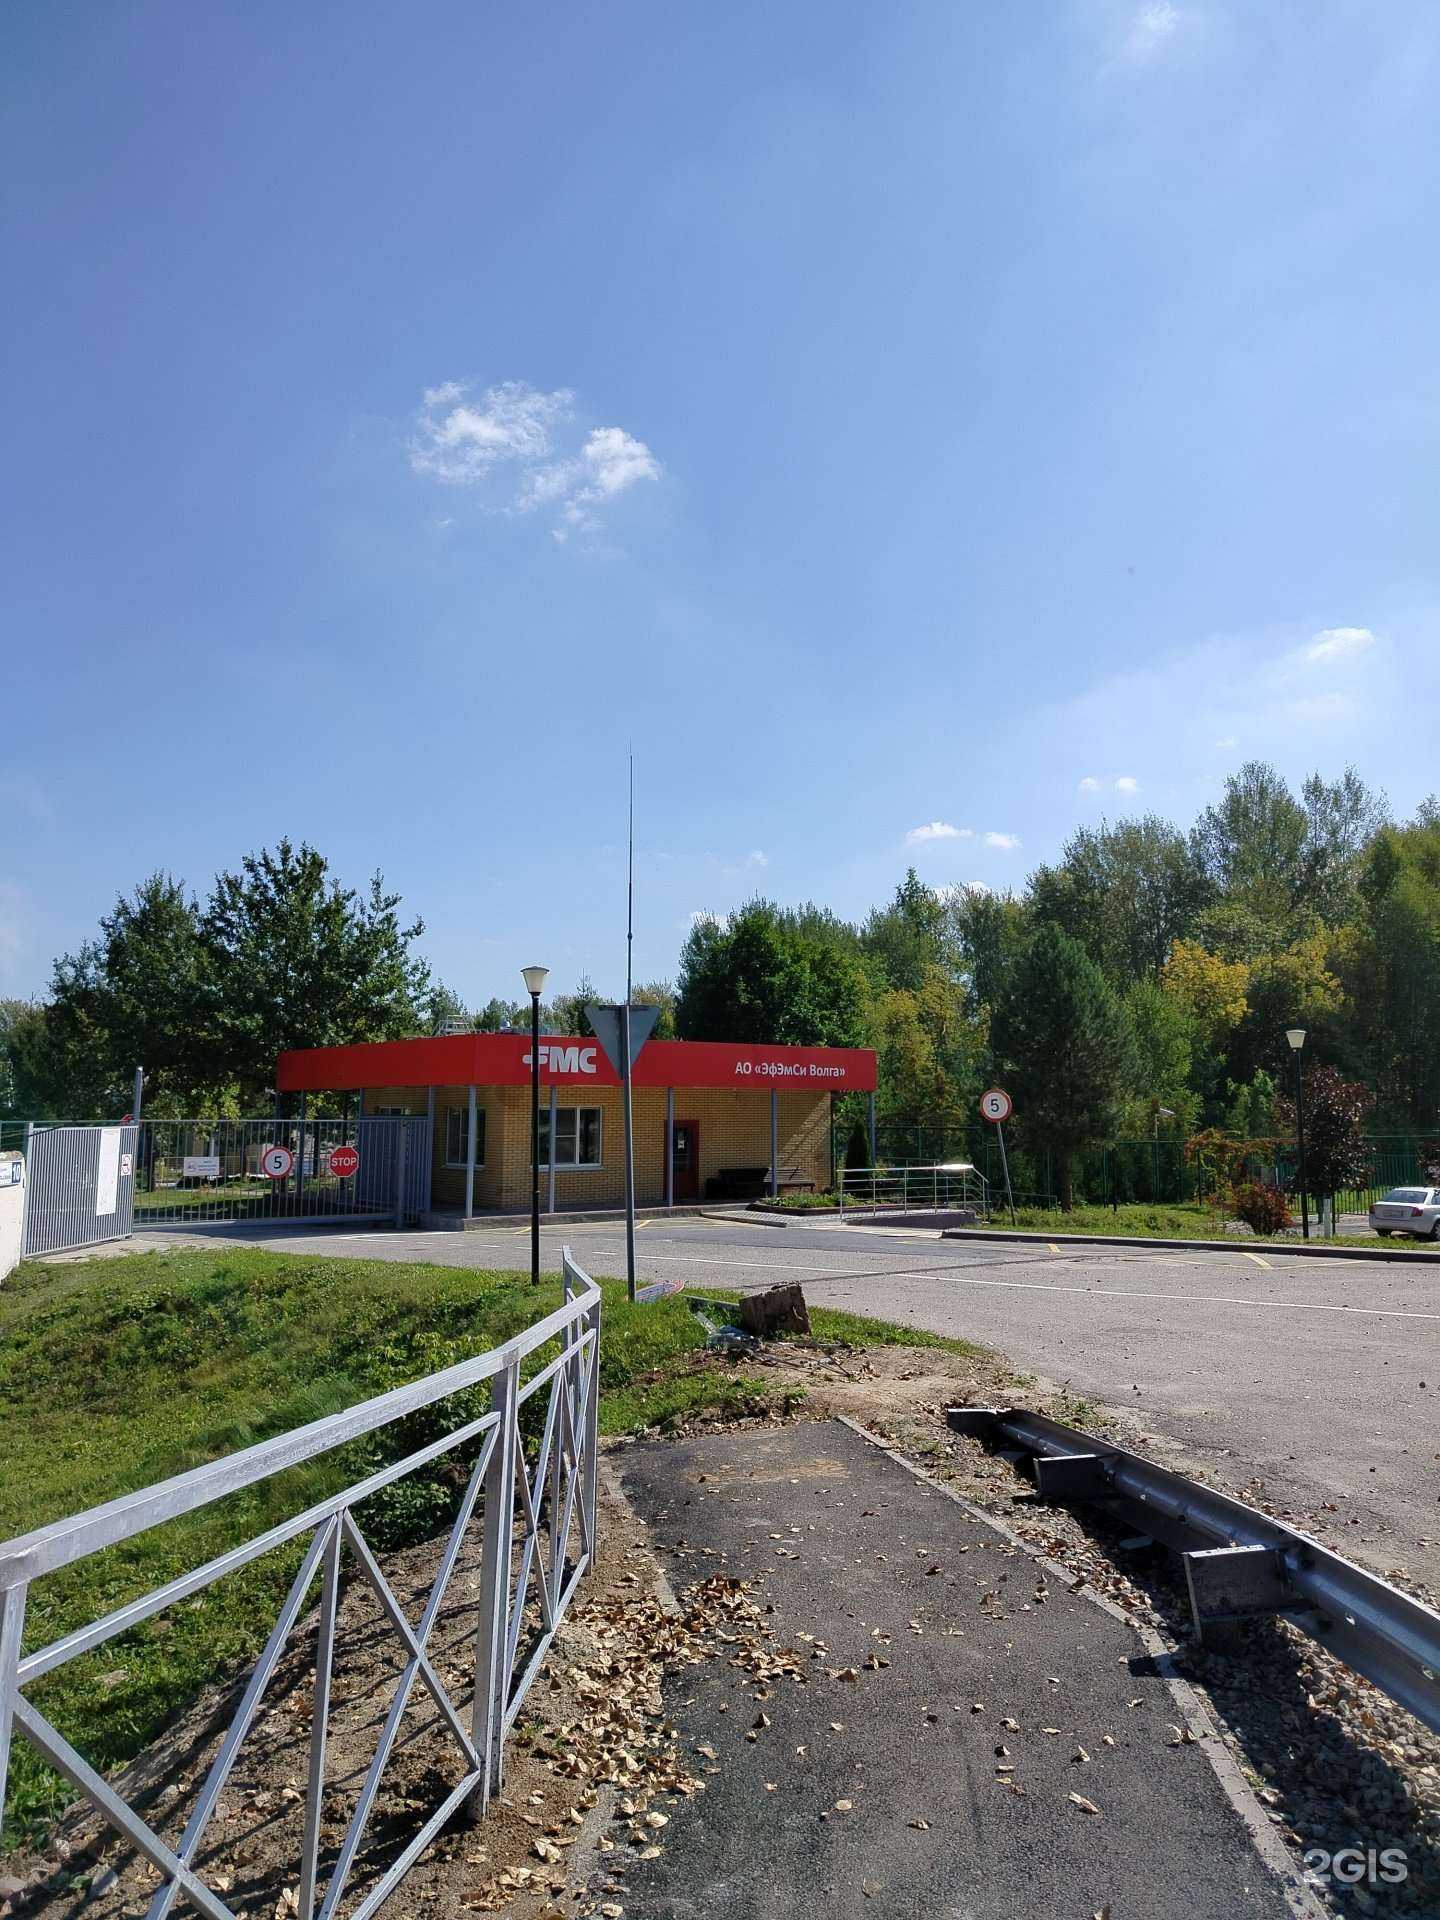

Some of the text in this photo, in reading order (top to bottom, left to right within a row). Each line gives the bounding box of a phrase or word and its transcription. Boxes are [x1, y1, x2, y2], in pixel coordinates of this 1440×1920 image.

[735, 1061, 846, 1078] АО «ЭфЭмСи Волга»
[991, 1098, 1000, 1113] 5
[273, 1155, 282, 1169] 5
[331, 1157, 357, 1167] STOP
